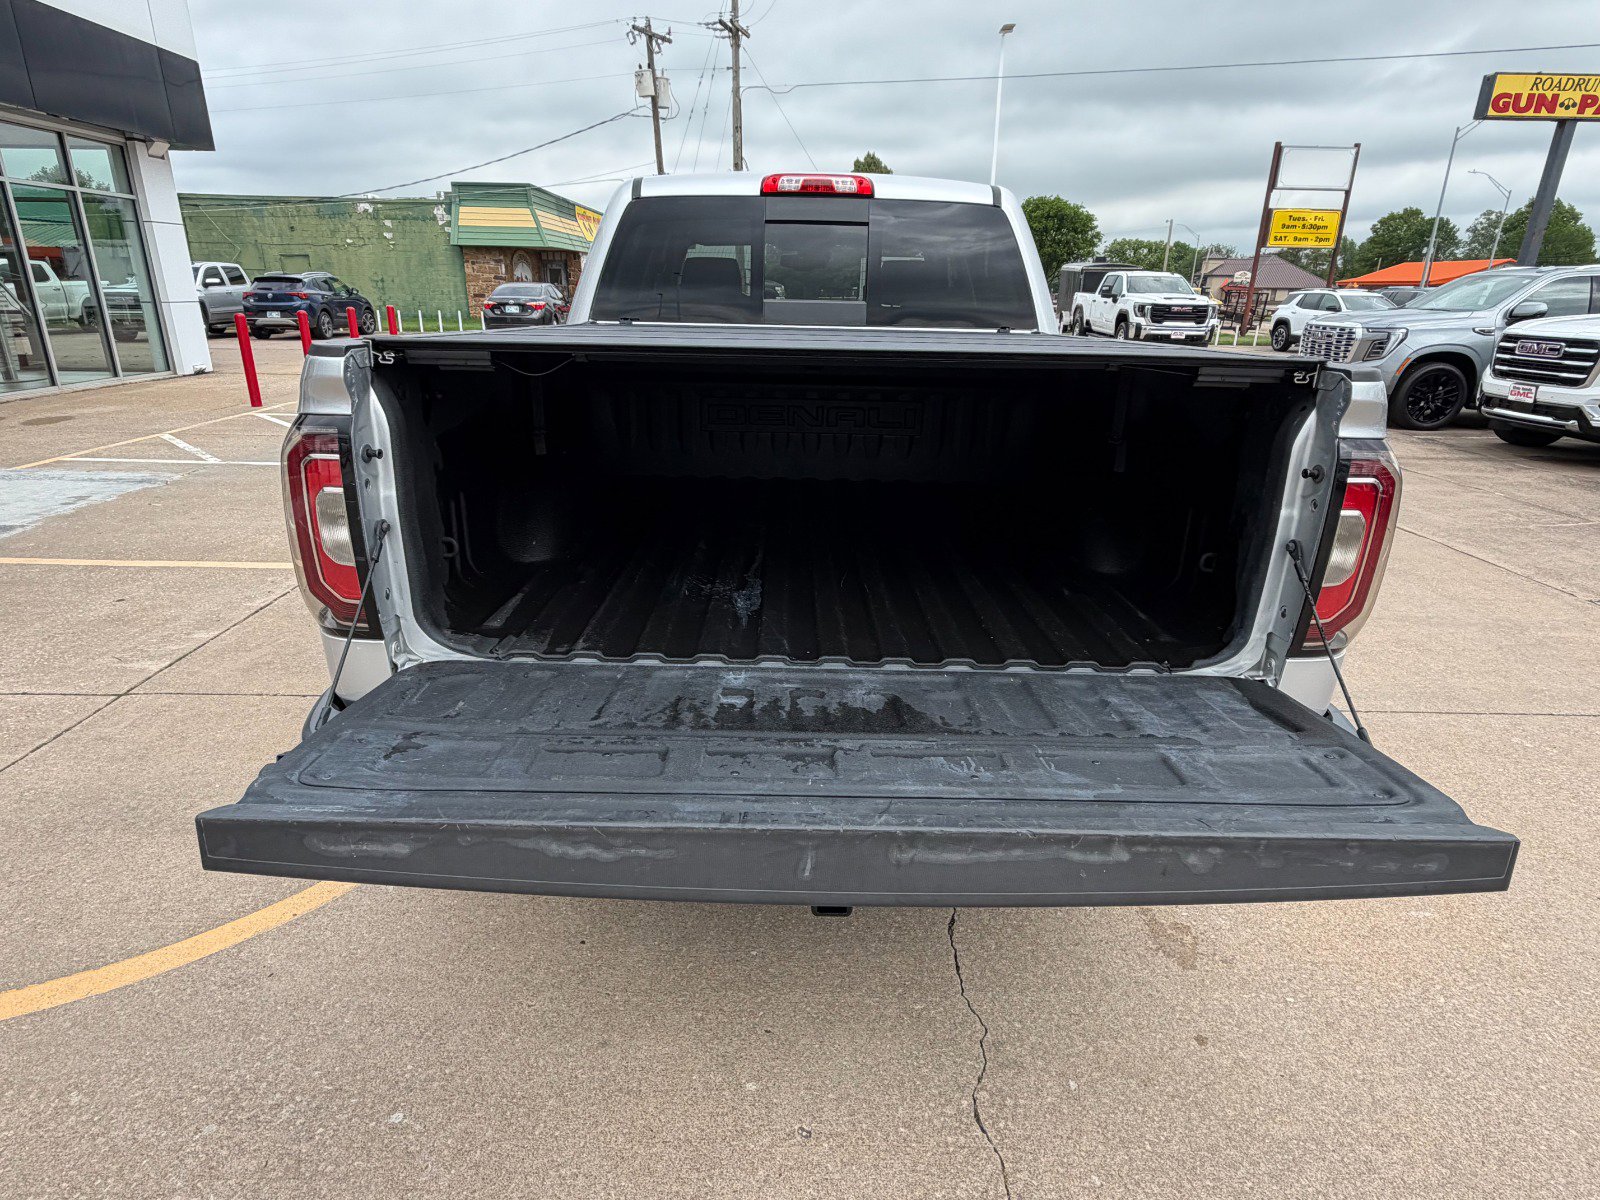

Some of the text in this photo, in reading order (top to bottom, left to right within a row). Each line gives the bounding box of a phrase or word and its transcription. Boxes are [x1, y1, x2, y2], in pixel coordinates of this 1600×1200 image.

[1491, 92, 1560, 114] GUN
[1518, 343, 1561, 355] GMC
[1509, 389, 1533, 399] GMC
[707, 403, 917, 430] DENALI
